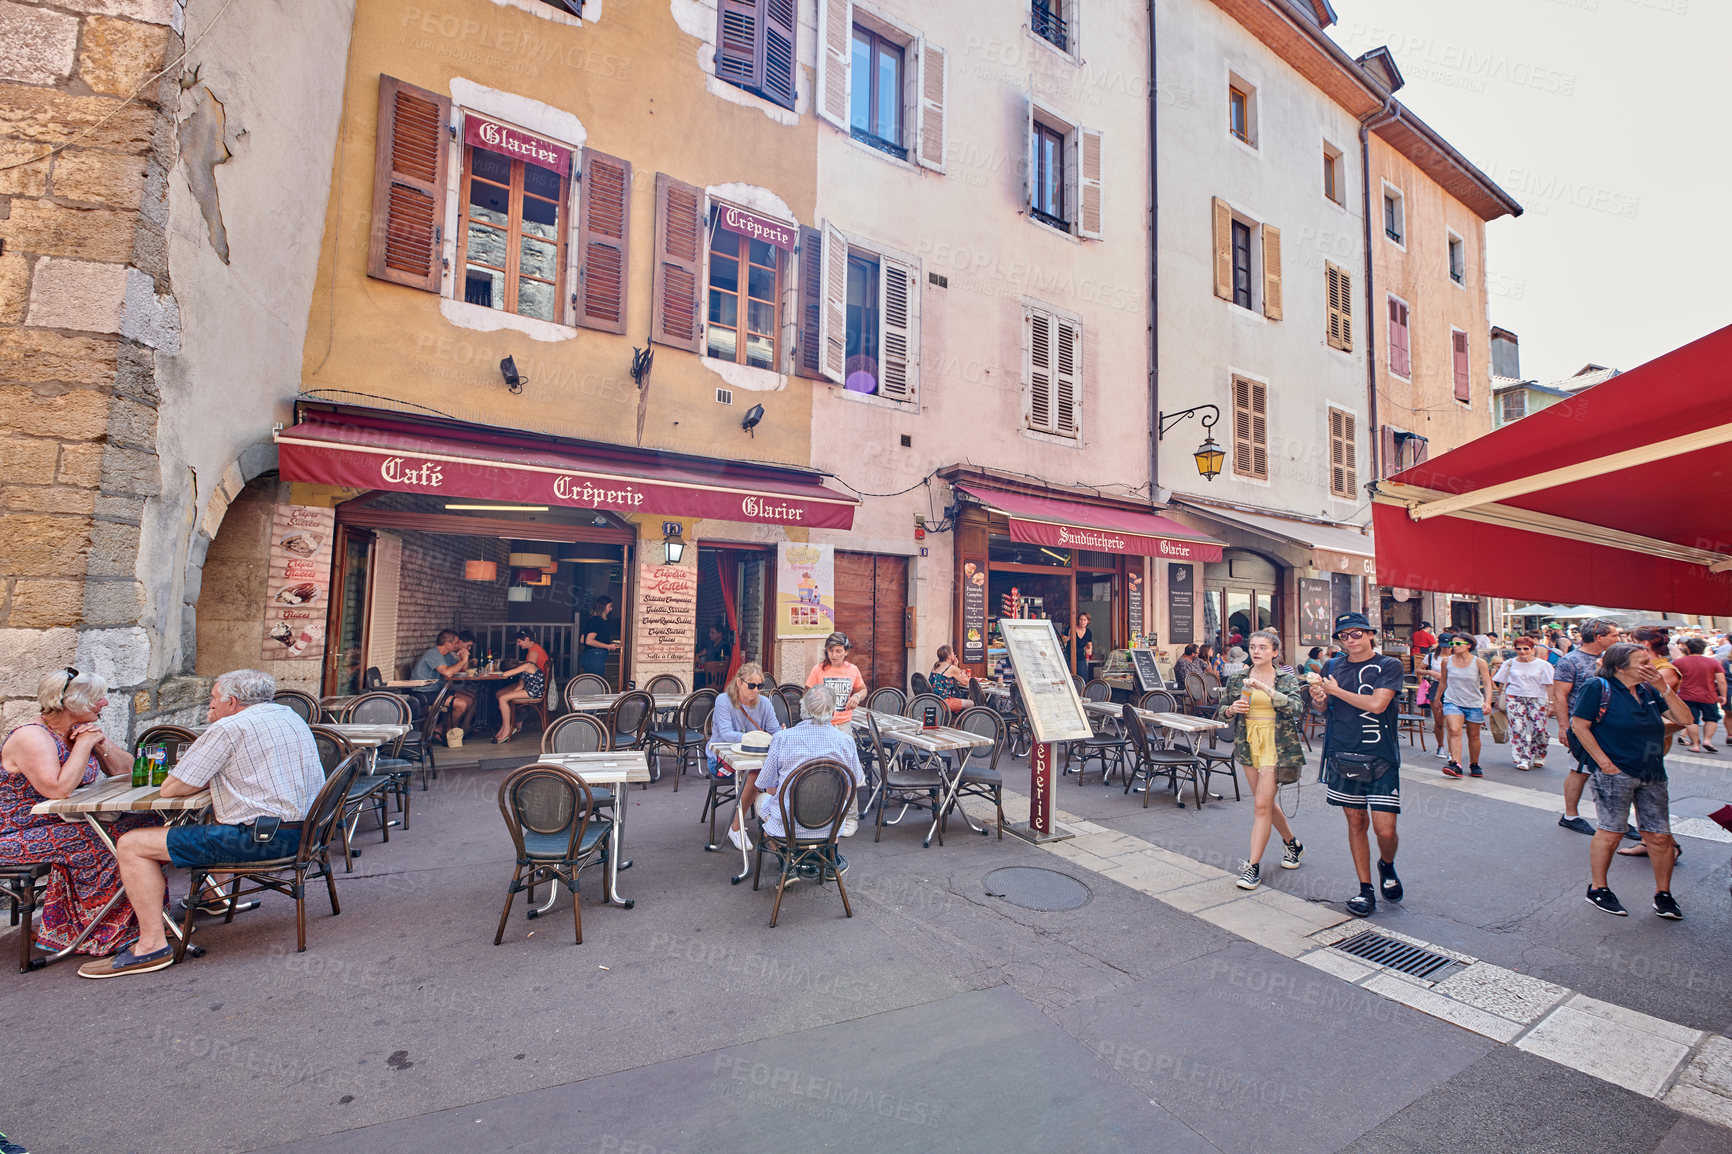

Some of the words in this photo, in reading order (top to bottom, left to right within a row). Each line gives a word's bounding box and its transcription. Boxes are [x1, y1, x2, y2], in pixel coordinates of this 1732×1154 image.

[479, 122, 558, 164] Glacier
[726, 208, 789, 244] Crêperie
[381, 456, 444, 487] Café
[553, 475, 644, 508] Crêperie
[742, 495, 804, 521] Glacier
[1058, 527, 1125, 551] Sandwicherie
[1160, 540, 1190, 557] Glacier
[653, 568, 687, 579] Crêperie
